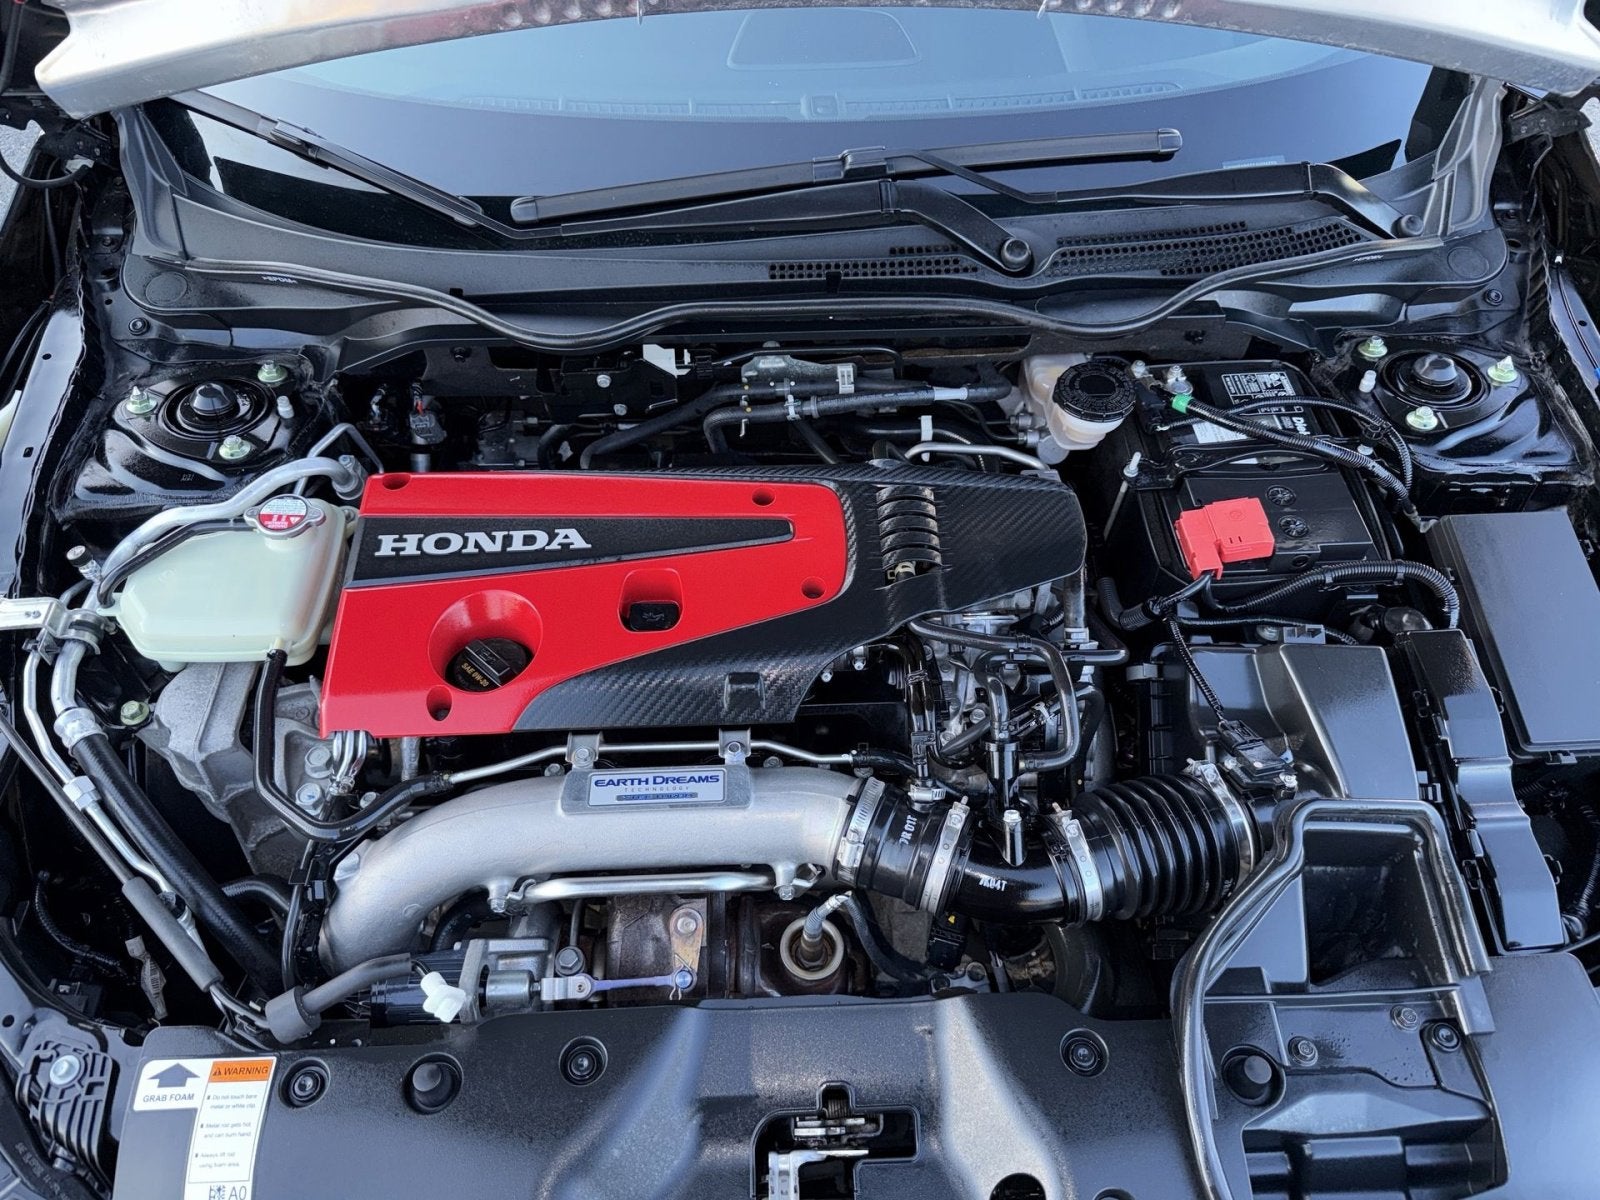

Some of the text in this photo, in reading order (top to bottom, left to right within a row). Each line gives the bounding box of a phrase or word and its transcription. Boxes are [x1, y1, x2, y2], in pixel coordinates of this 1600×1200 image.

[374, 528, 592, 557] HONDA
[461, 662, 490, 687] SAE 0W-20
[594, 775, 720, 787] EARTH DREAMS
[224, 1066, 268, 1076] WARNING
[143, 1093, 195, 1103] GRAB FOAM
